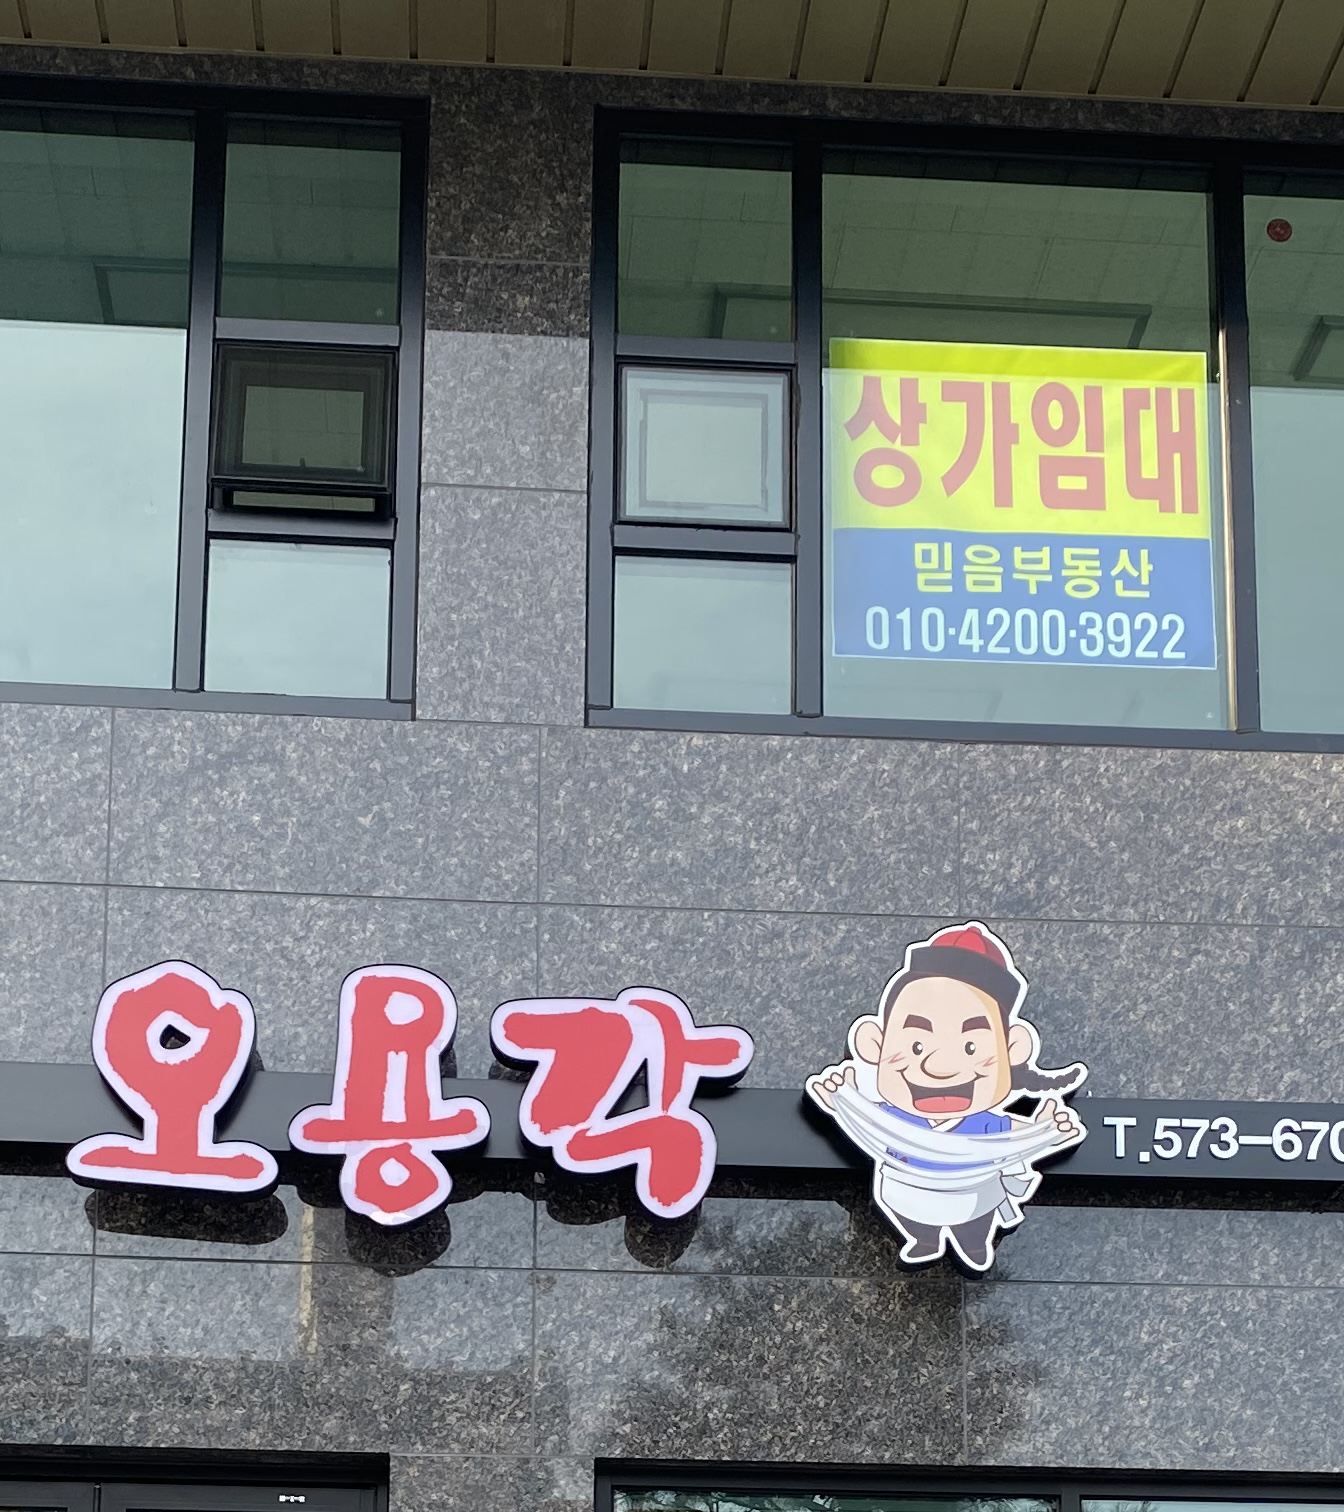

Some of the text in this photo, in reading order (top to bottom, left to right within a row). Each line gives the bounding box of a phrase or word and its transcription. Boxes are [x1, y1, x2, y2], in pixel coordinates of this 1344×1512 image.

[845, 375, 1200, 515] 상가임대
[914, 541, 1154, 599] 믿음부동산
[67, 959, 754, 1227] 오용각
